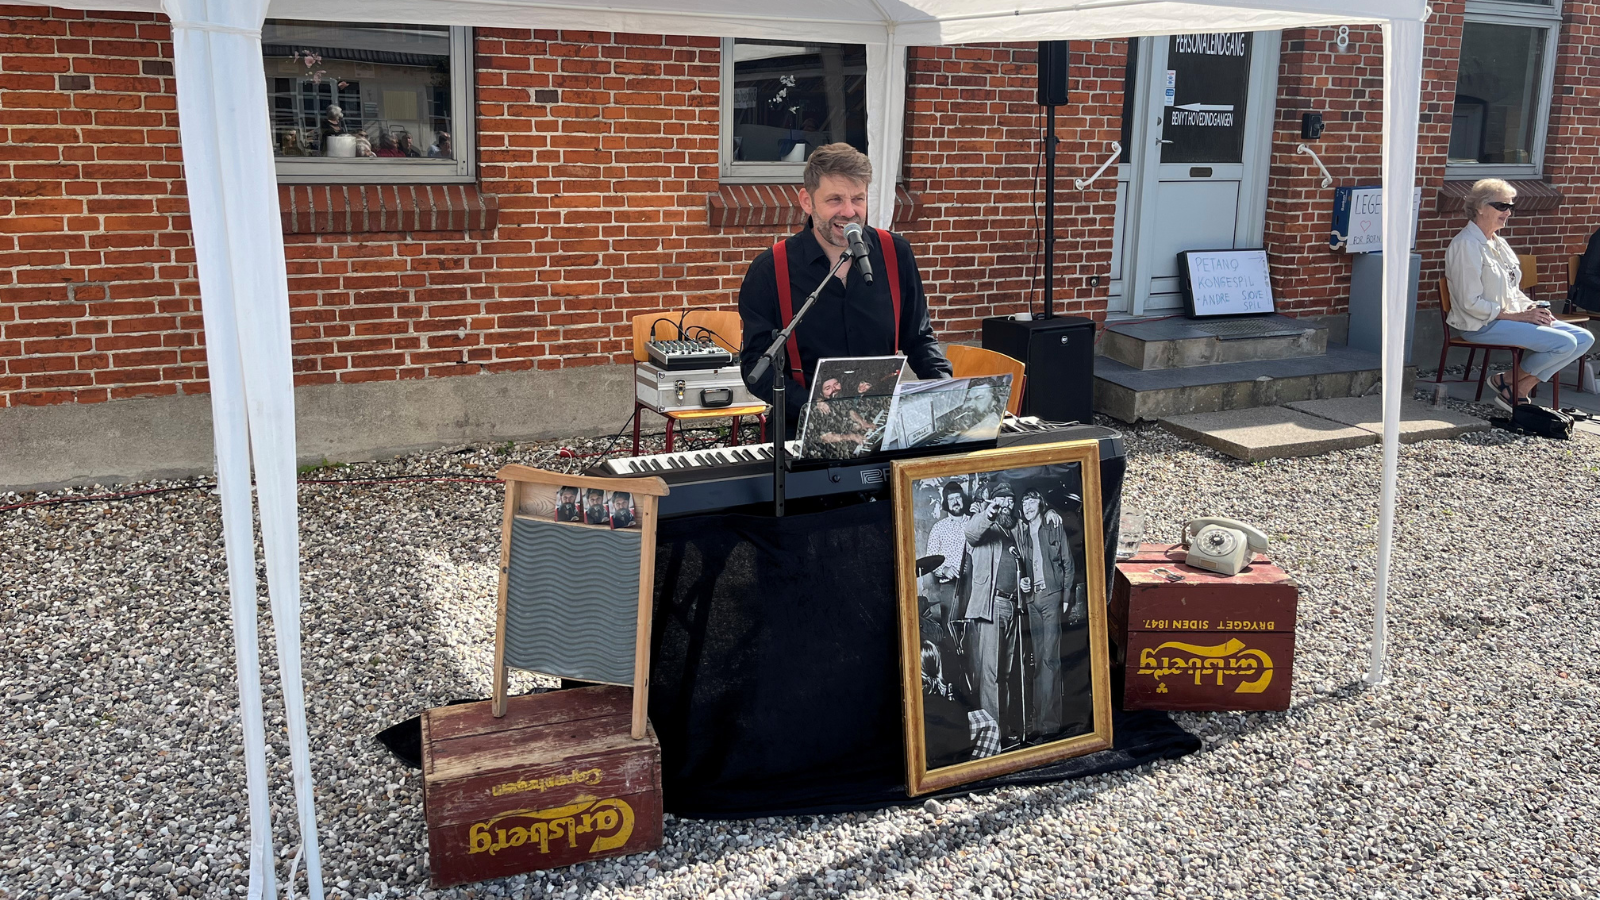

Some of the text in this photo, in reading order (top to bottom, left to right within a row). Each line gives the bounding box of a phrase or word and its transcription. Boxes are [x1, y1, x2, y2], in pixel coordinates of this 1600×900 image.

[1337, 25, 1349, 47] 8
[1142, 619, 1275, 630] BRYGGET SIDEN 1847.
[1136, 637, 1274, 694] Carlsberg
[467, 795, 635, 856] Carlsberg
